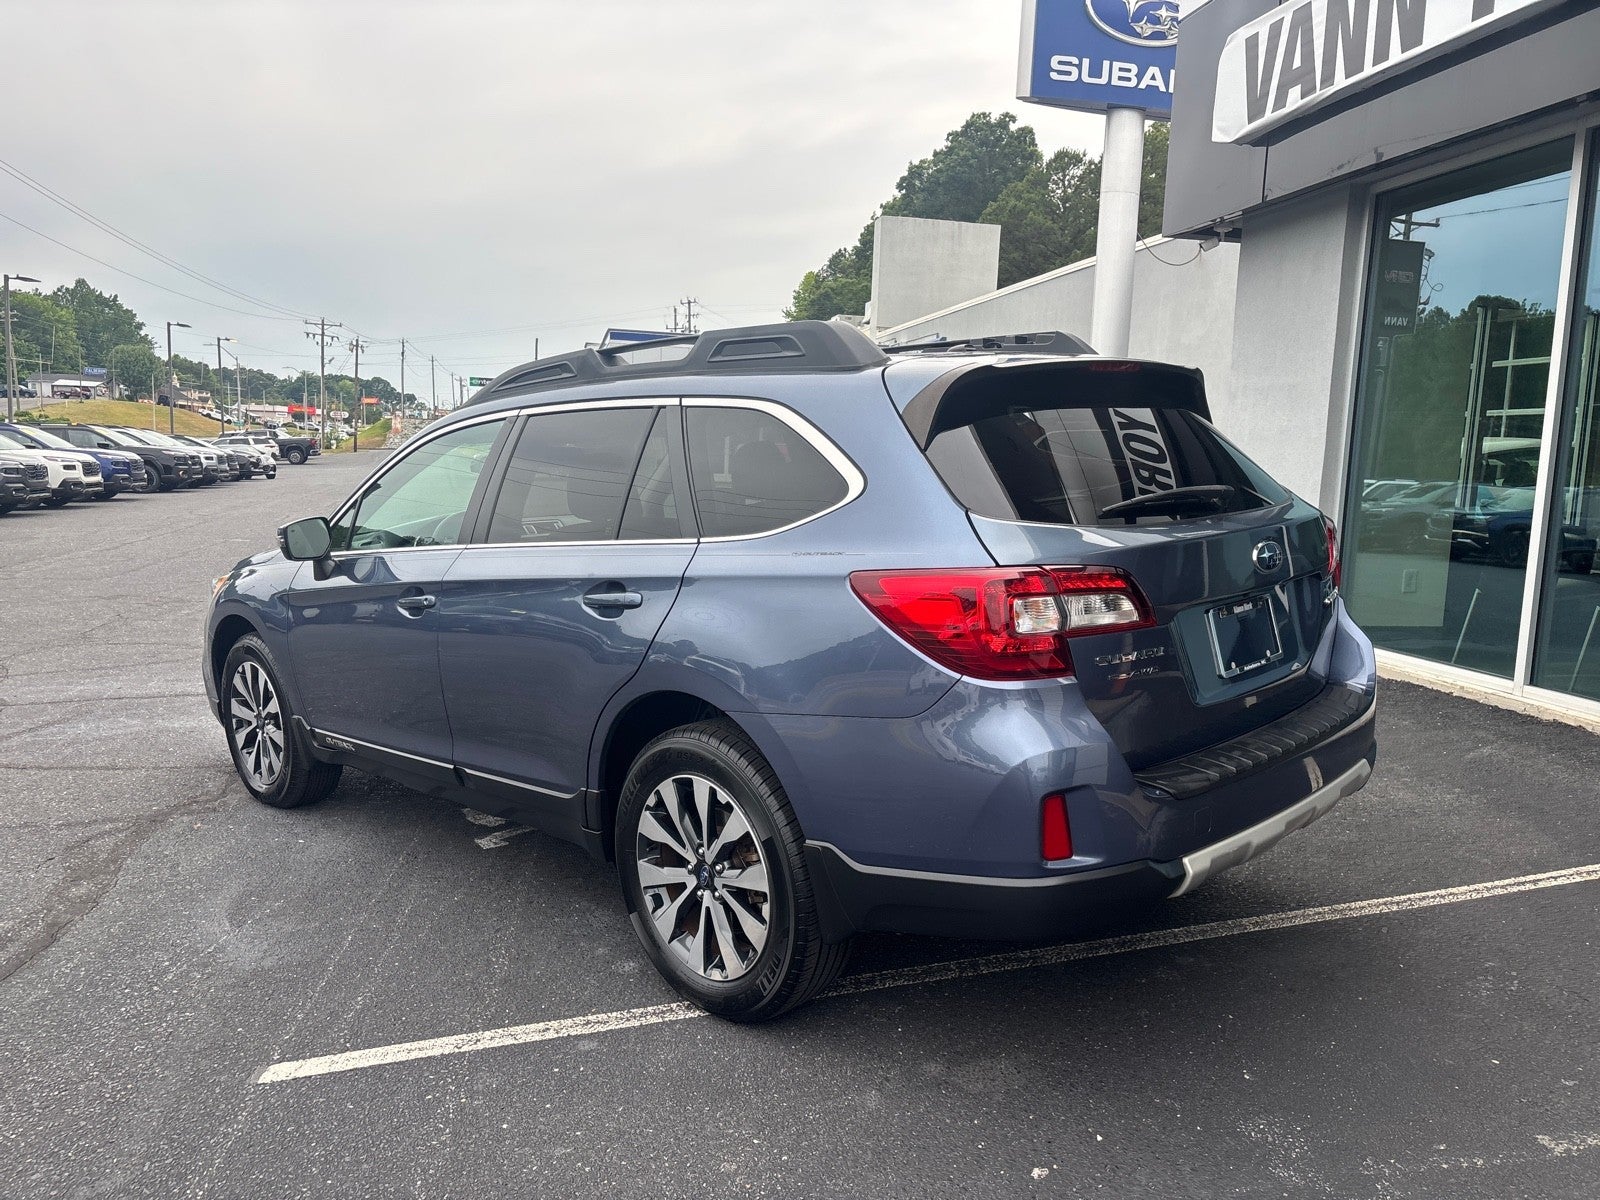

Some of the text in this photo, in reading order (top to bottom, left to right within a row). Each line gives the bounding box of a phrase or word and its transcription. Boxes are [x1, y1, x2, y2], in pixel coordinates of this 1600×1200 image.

[1049, 55, 1175, 93] SUBA
[1244, 0, 1427, 125] VANN
[1095, 647, 1165, 667] SUBARU
[325, 737, 356, 751] OUTBACK
